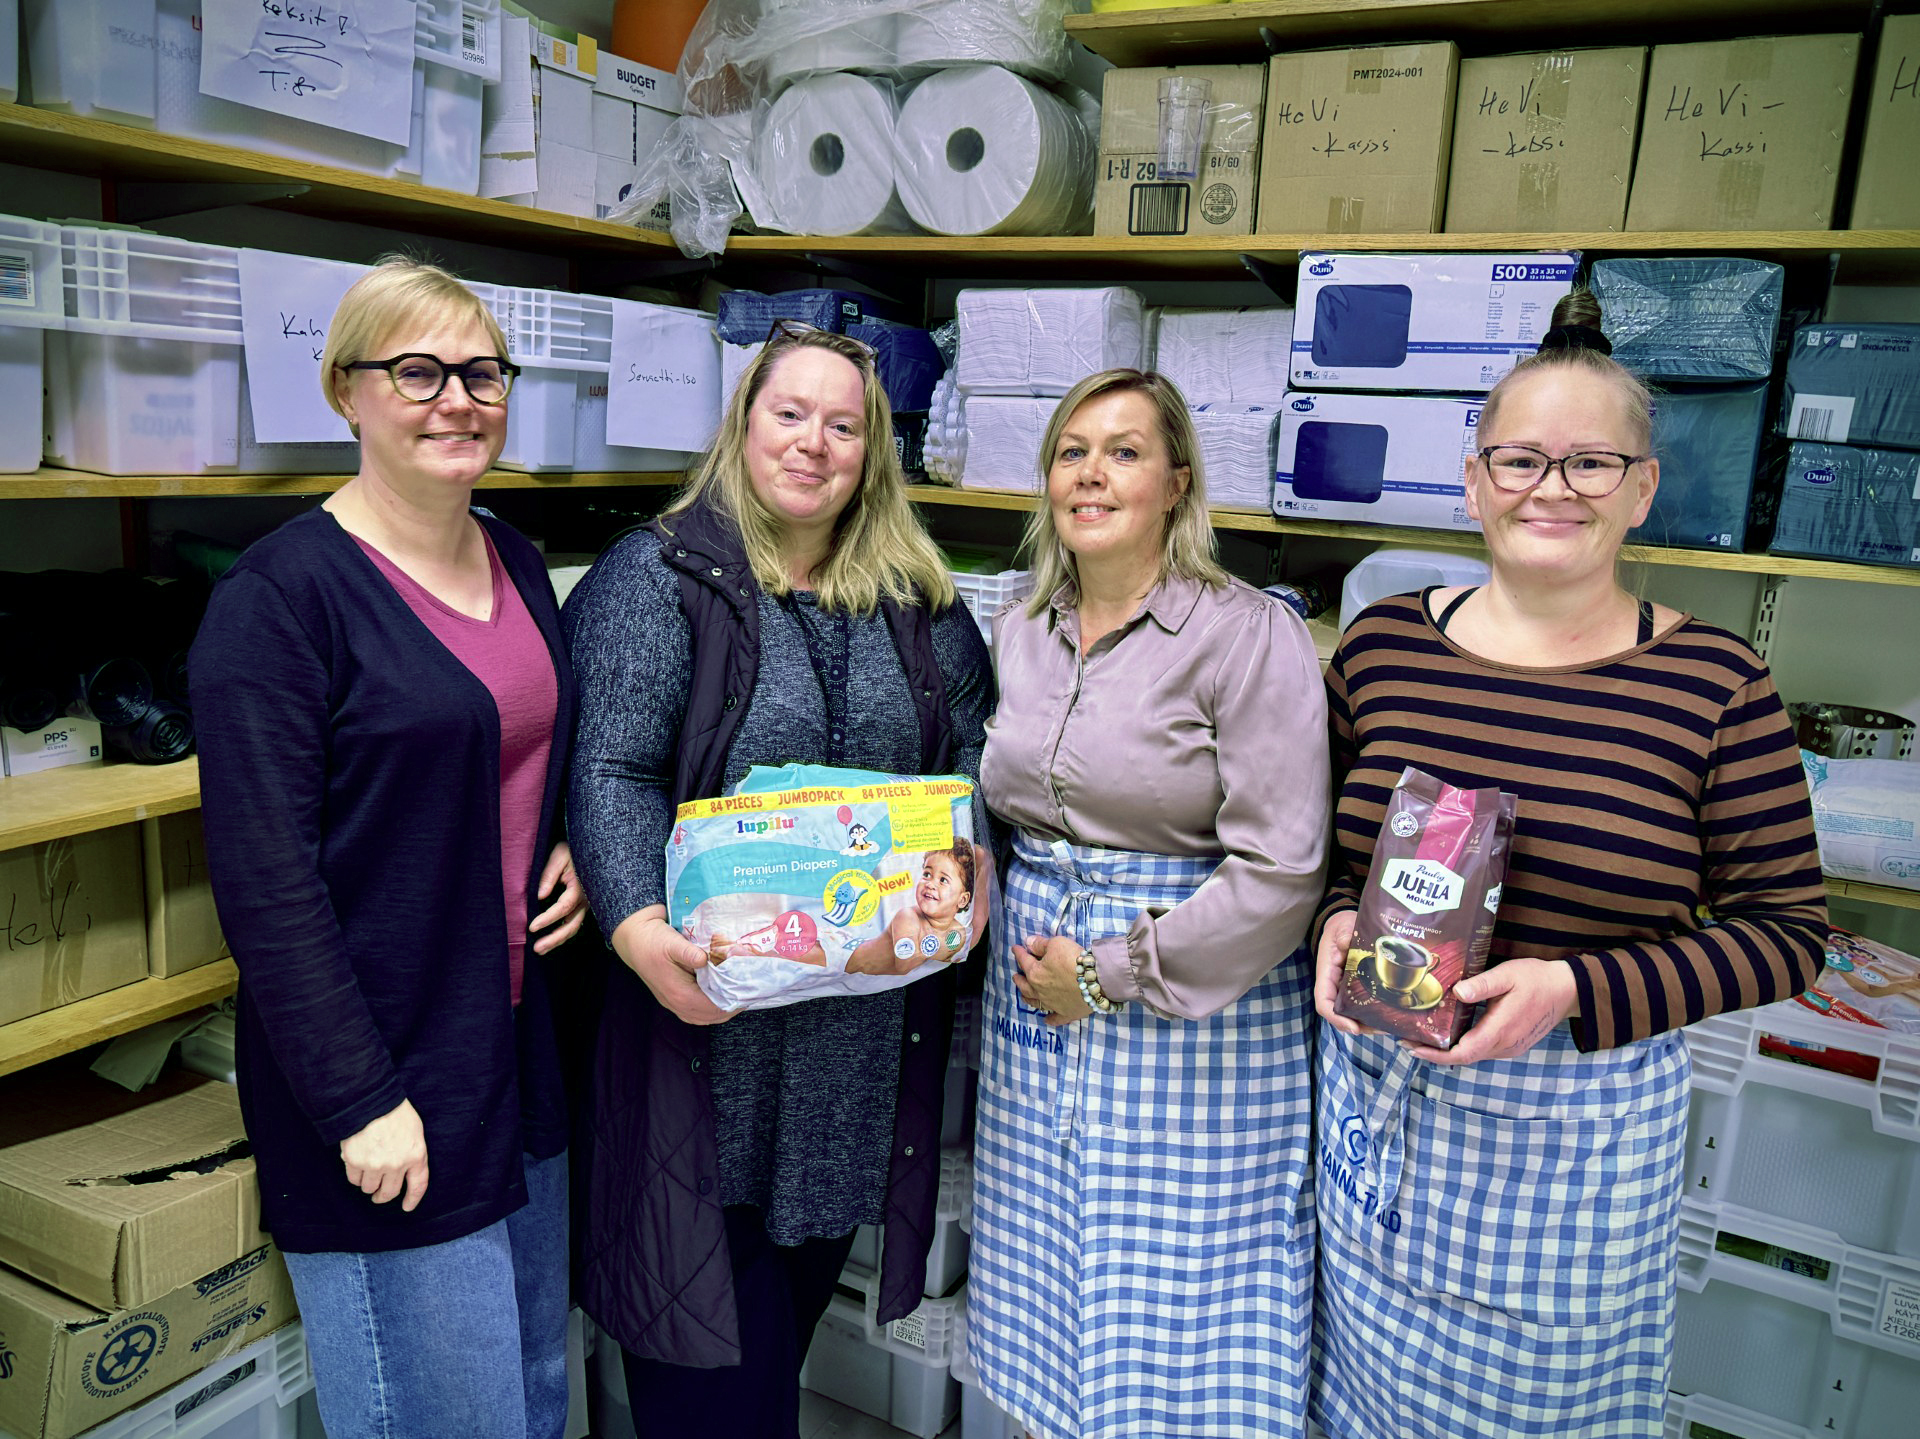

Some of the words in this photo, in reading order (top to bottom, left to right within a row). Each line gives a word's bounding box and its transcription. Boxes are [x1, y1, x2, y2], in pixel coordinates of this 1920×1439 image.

[616, 68, 656, 91] BUDGET
[1352, 67, 1424, 81] PMT2024-001
[650, 208, 672, 221] PAPE
[1493, 265, 1528, 280] 500
[1806, 472, 1833, 482] Duni
[44, 731, 68, 744] PPS
[710, 801, 723, 813] 84
[725, 795, 764, 810] PIECES
[778, 788, 846, 806] JUMBOPACK
[862, 788, 875, 799] 84
[876, 785, 913, 798] PIECES
[737, 816, 796, 835] lupilu
[733, 862, 788, 877] Premium
[790, 858, 839, 874] Diapers
[1415, 864, 1446, 883] Paulig
[733, 878, 748, 888] soft
[755, 876, 768, 887] dry
[878, 872, 912, 893] New!
[1391, 870, 1451, 901] JUHLA
[1405, 893, 1436, 908] MOKKA
[784, 914, 804, 938] 4
[1390, 923, 1426, 940] LEMPEÄ
[996, 1014, 1064, 1057] MANNA-TA
